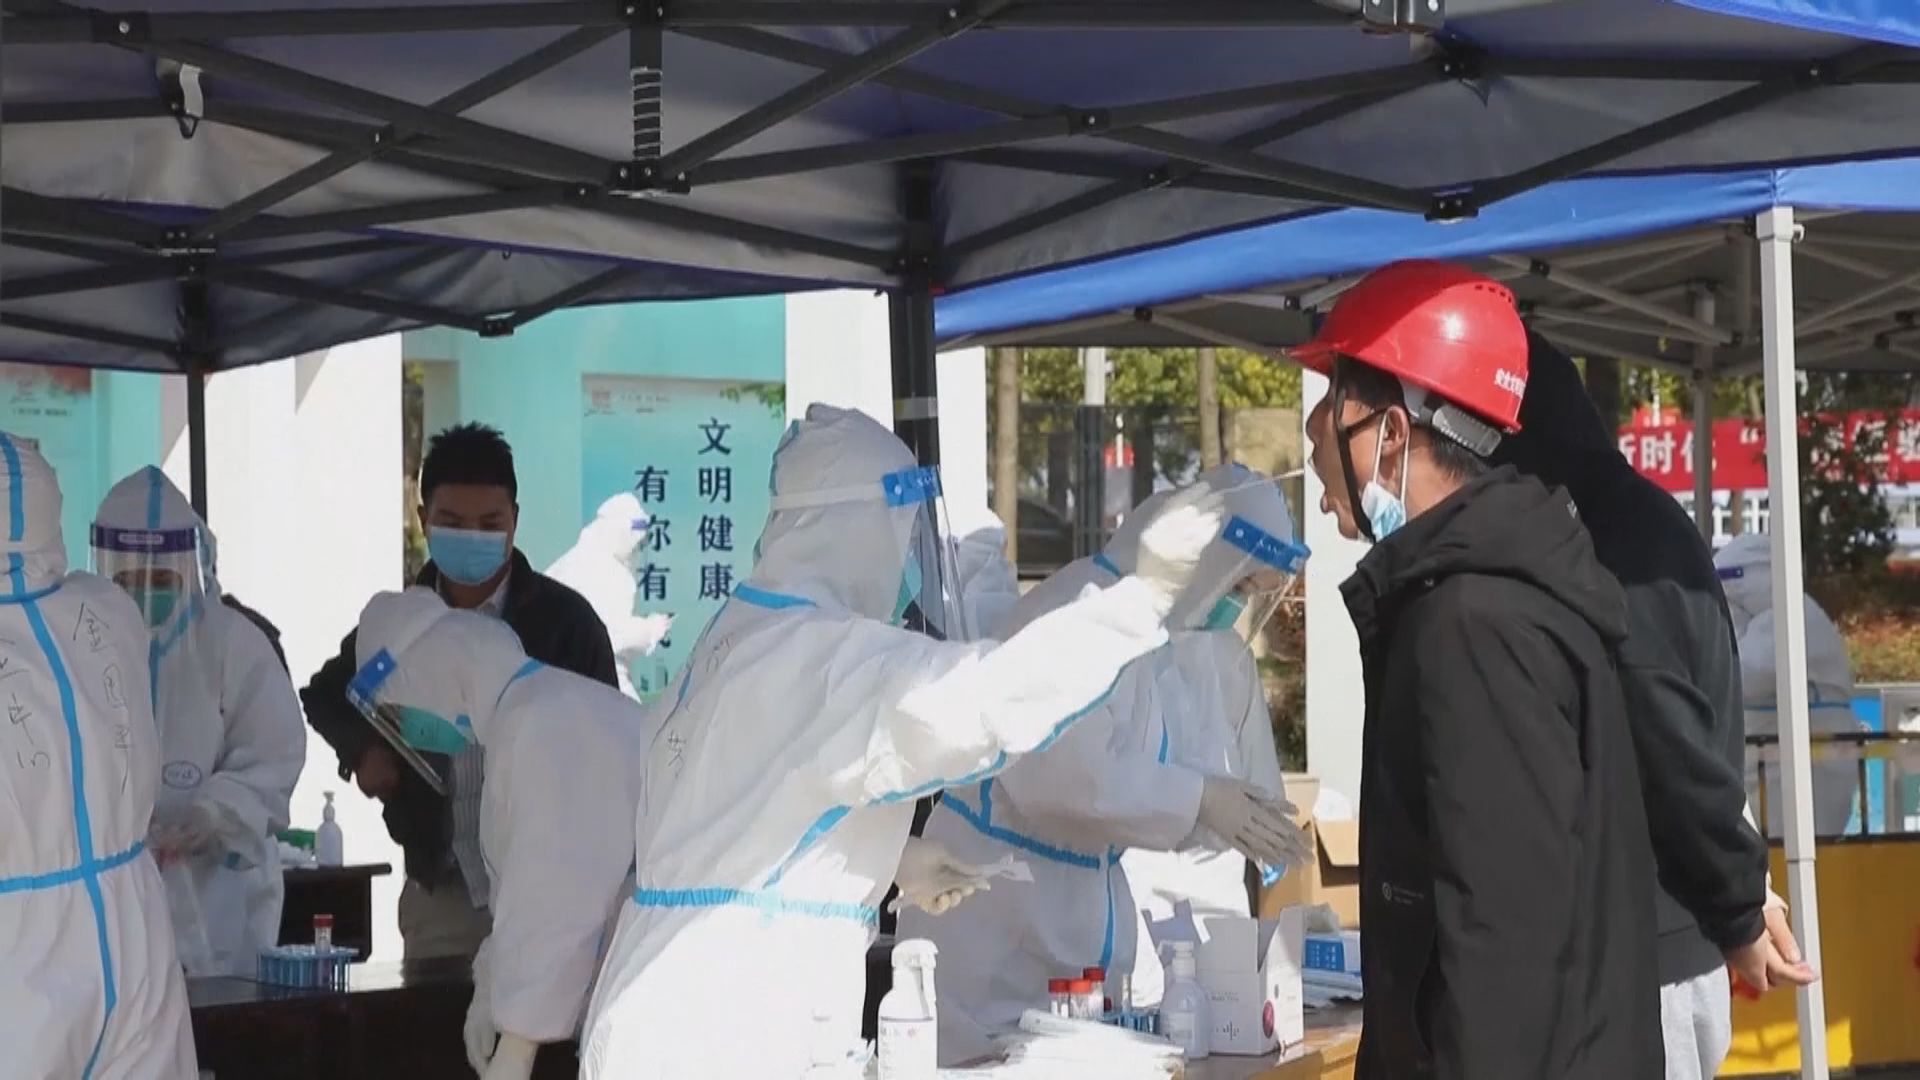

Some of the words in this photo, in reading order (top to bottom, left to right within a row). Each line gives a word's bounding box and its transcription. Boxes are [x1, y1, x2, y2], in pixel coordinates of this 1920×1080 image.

[634, 465, 672, 649] 有你有
[697, 417, 734, 601] 文明健康
